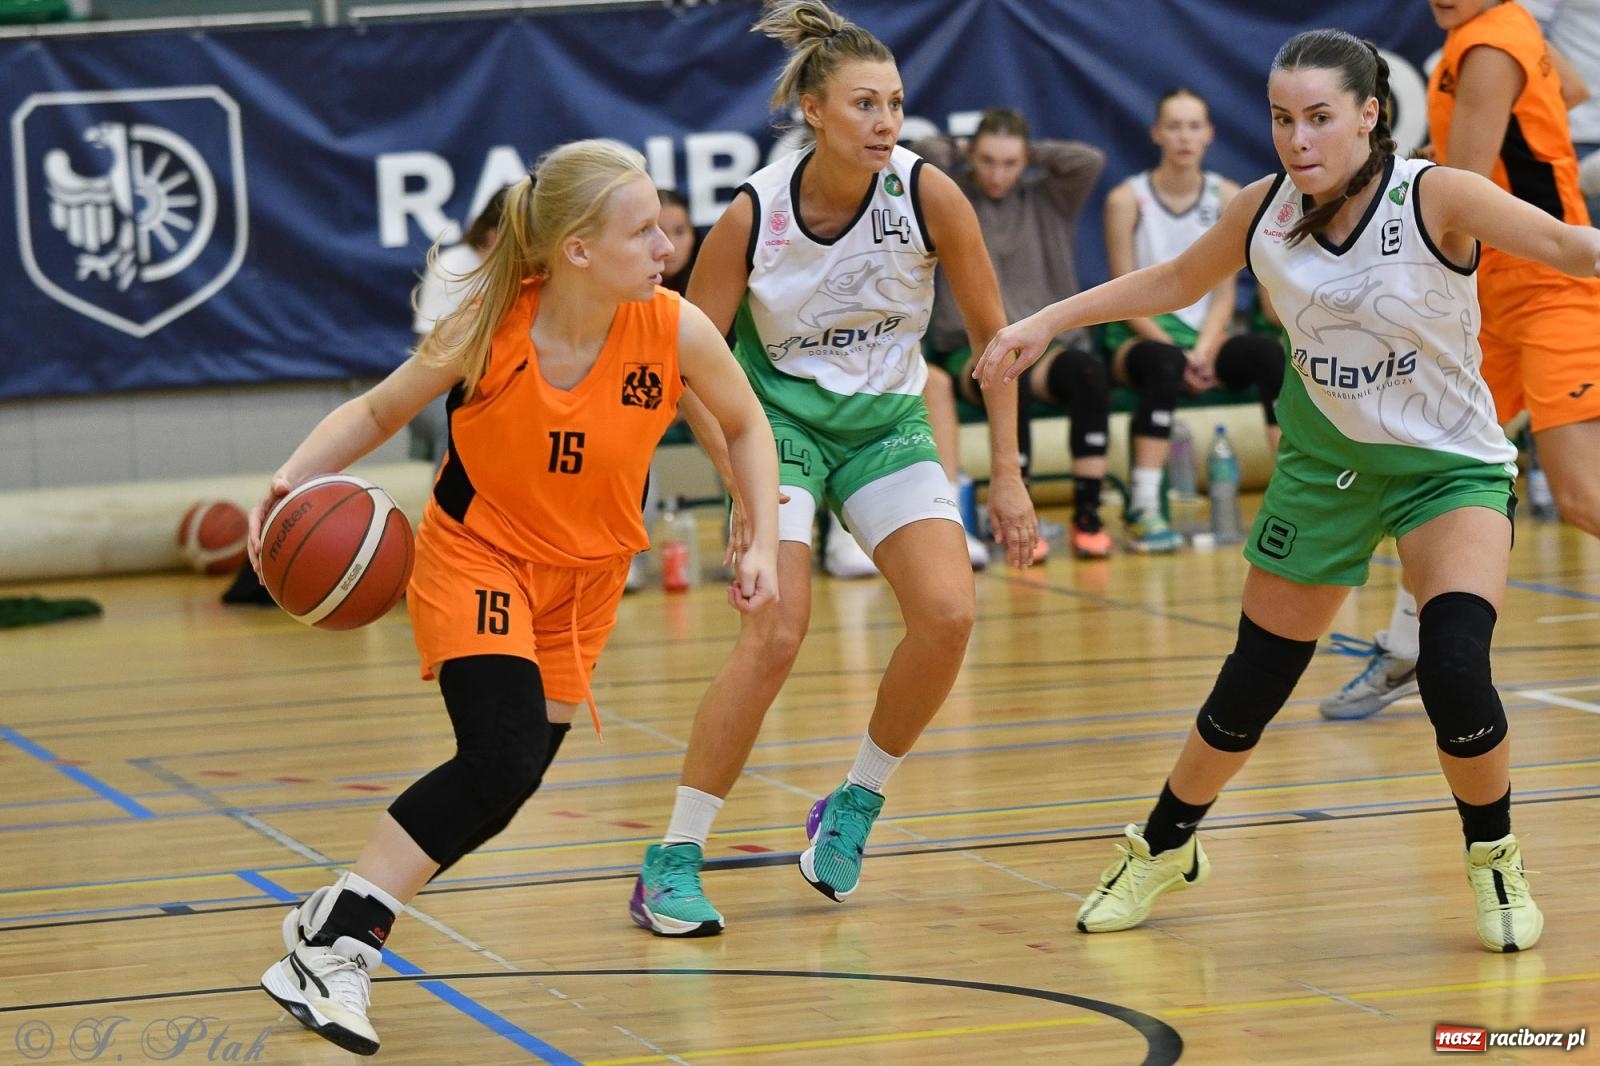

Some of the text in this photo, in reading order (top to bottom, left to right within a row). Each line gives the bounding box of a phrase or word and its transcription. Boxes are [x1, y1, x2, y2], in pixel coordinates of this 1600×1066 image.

[871, 208, 912, 245] 14
[1381, 218, 1403, 256] 8
[1310, 350, 1417, 389] Clavis
[546, 430, 586, 475] 15
[775, 438, 812, 477] 4
[268, 499, 313, 562] molten
[1256, 514, 1298, 560] 8
[474, 588, 511, 636] 15
